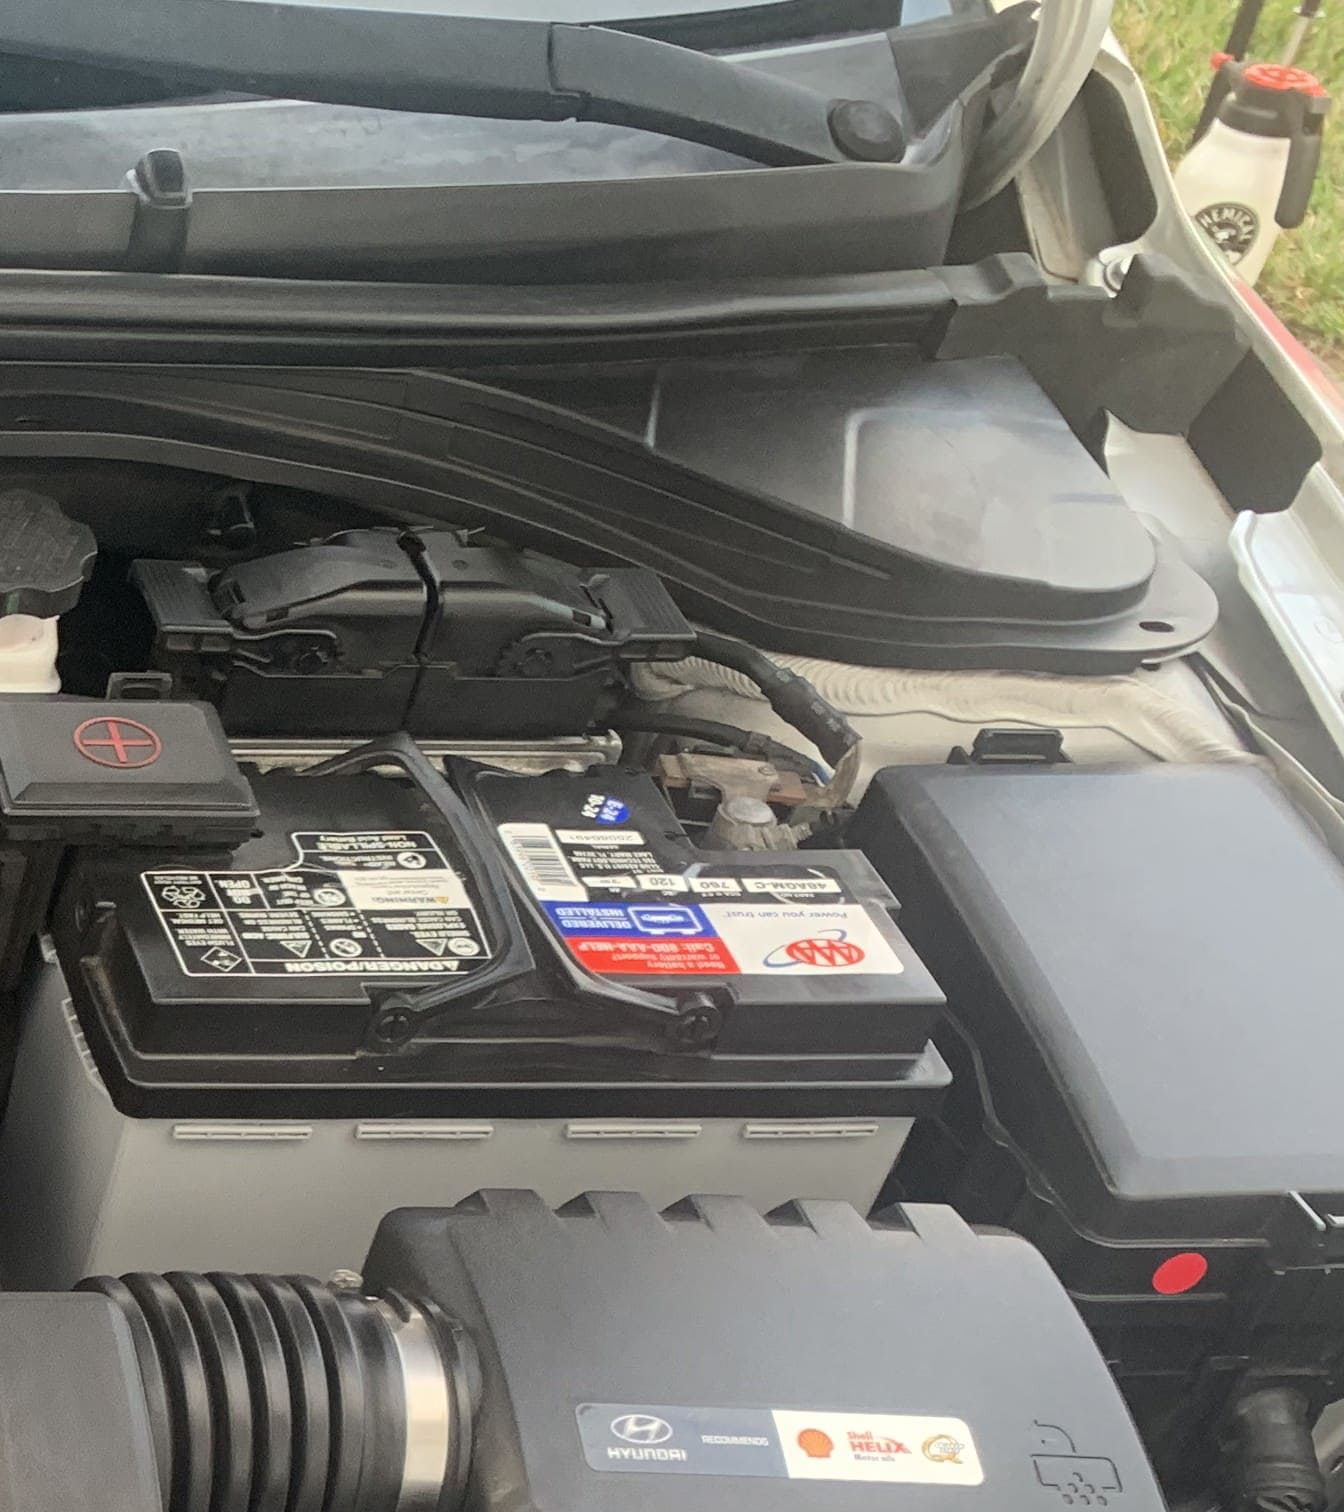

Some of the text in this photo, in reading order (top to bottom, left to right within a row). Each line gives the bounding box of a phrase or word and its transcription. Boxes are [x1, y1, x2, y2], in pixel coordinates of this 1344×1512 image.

[214, 879, 250, 889] OPEN.
[555, 907, 624, 917] INSTALLED
[782, 910, 805, 918] you
[560, 919, 632, 930] DELIVERED
[578, 941, 715, 953] Call: 800-AAA-HELP
[788, 939, 863, 967] AAA
[284, 960, 445, 972] DANGER/POISON
[646, 960, 686, 970] battery
[696, 962, 726, 970] Need
[701, 1434, 769, 1447] RECOMMENDS
[847, 1430, 874, 1441] Shell
[850, 1440, 908, 1454] HELIX
[608, 1447, 688, 1462] HYUNDAI
